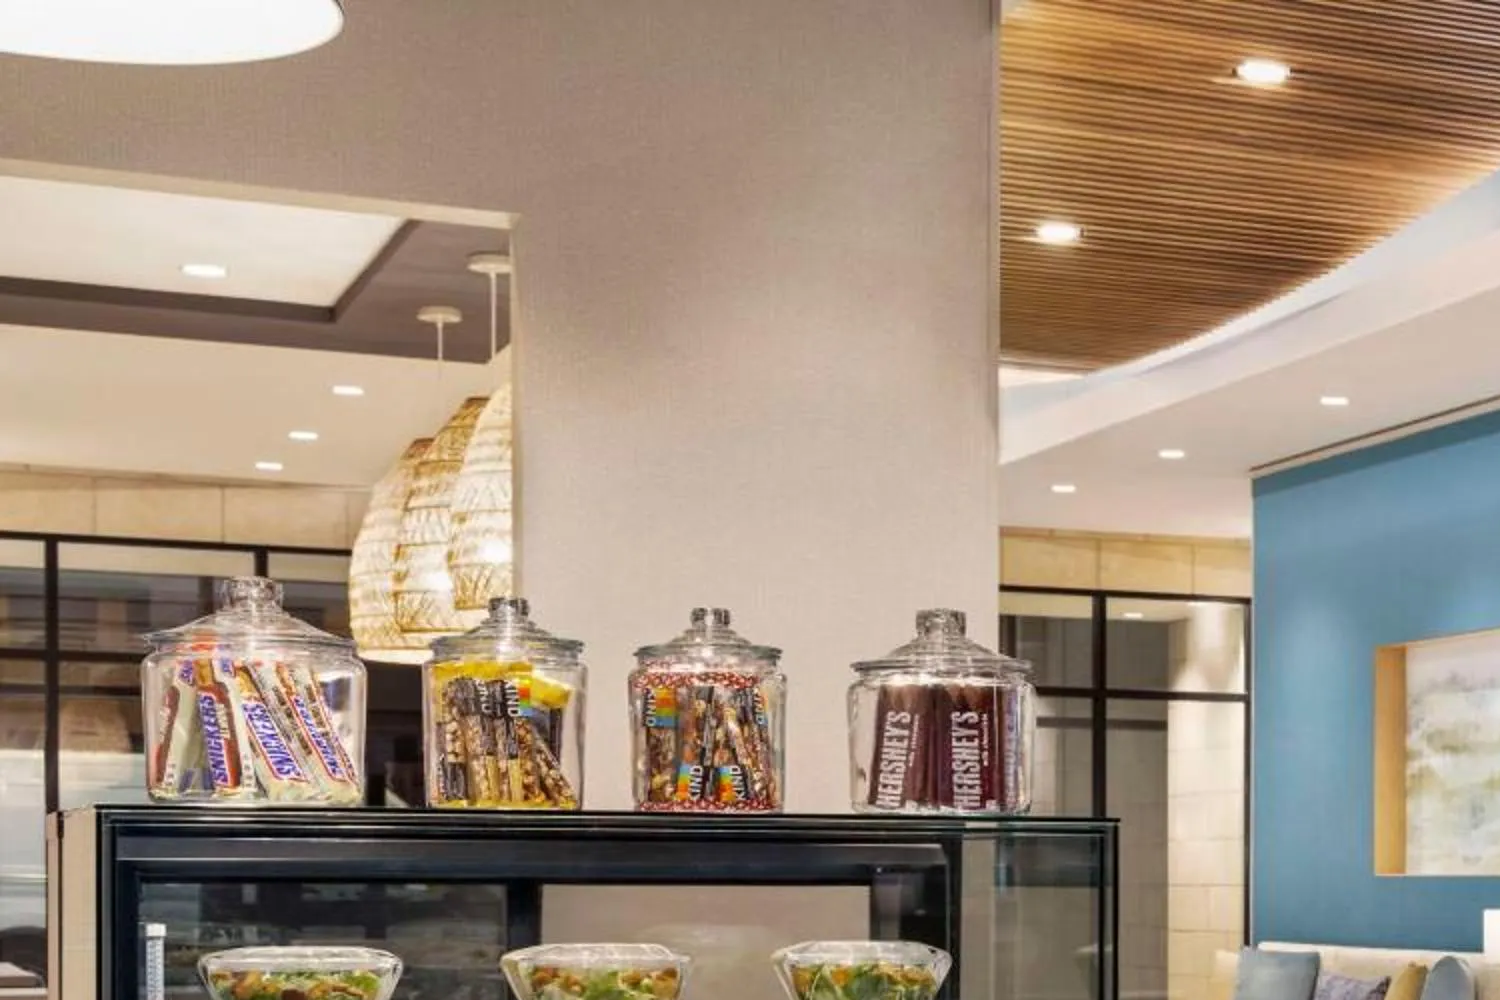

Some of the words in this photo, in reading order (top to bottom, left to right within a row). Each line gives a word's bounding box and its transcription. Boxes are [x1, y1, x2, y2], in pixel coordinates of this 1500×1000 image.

[199, 694, 230, 784] SNICKERS
[503, 680, 520, 717] KIND
[242, 703, 301, 777] SNICKERS
[875, 710, 911, 808] HERSHEY'S
[951, 710, 982, 808] HERSHEY'S
[730, 765, 745, 800] KIND
